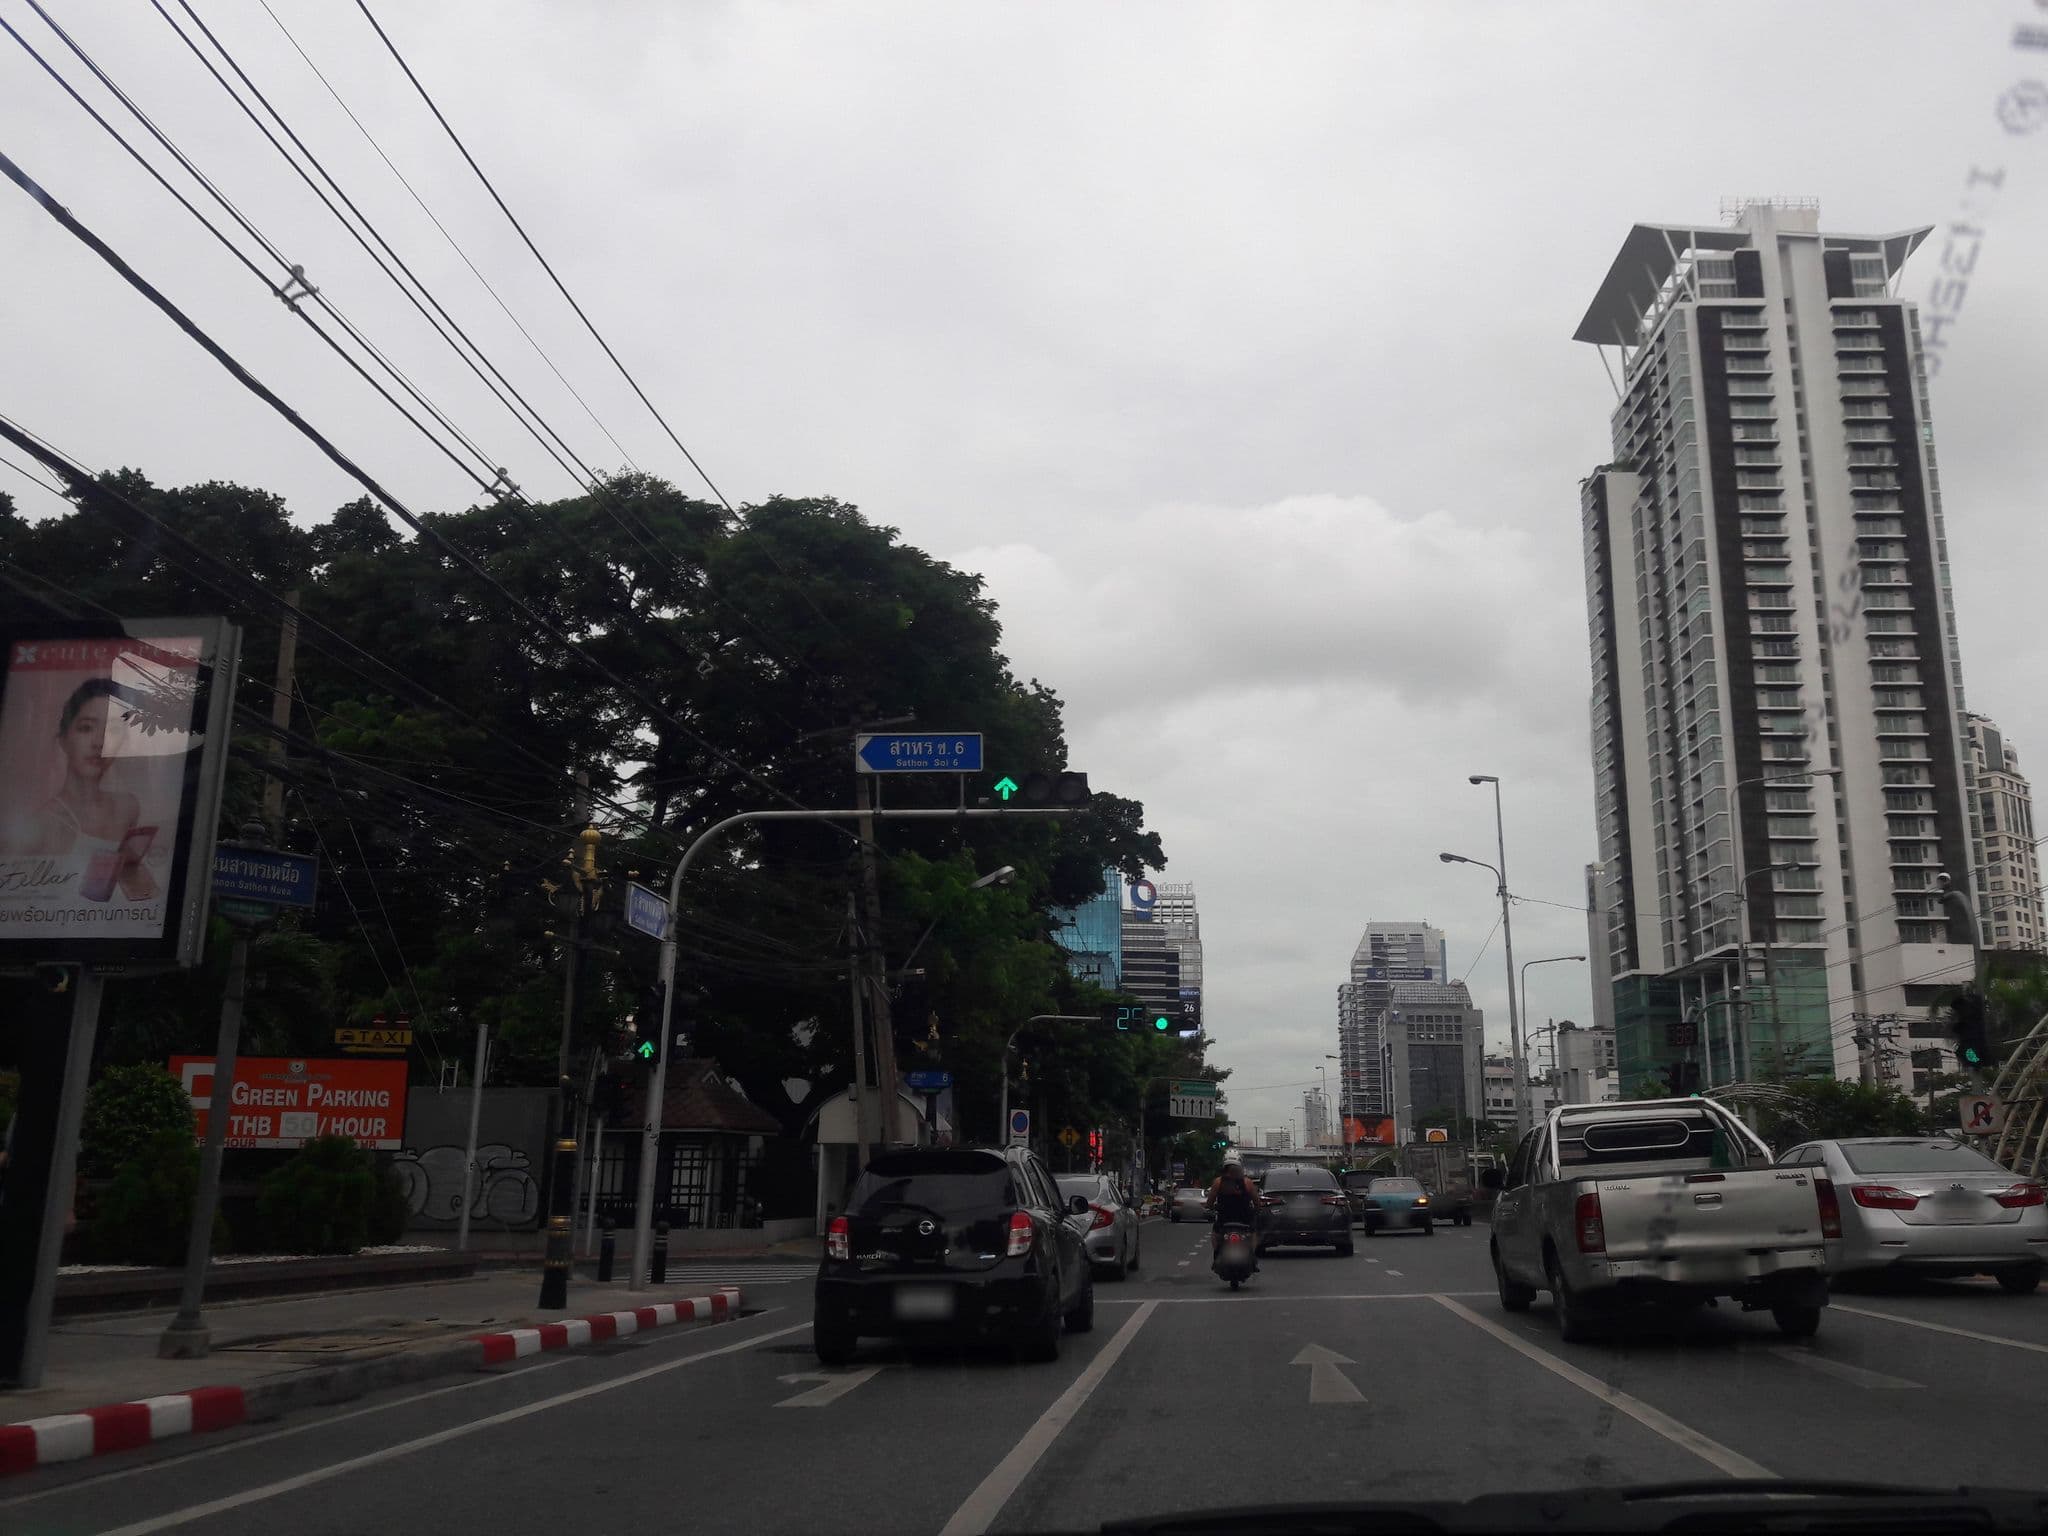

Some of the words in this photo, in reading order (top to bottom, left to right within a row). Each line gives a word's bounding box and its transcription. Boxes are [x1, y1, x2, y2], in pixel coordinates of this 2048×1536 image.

[890, 741, 933, 756] สาทร
[954, 741, 965, 755] 6
[896, 759, 928, 767] Sathon
[934, 759, 948, 767] Soi
[360, 1031, 404, 1044] TAXI
[231, 1081, 298, 1107] GREEN
[307, 1083, 390, 1108] PARKING
[230, 1116, 272, 1136] THB
